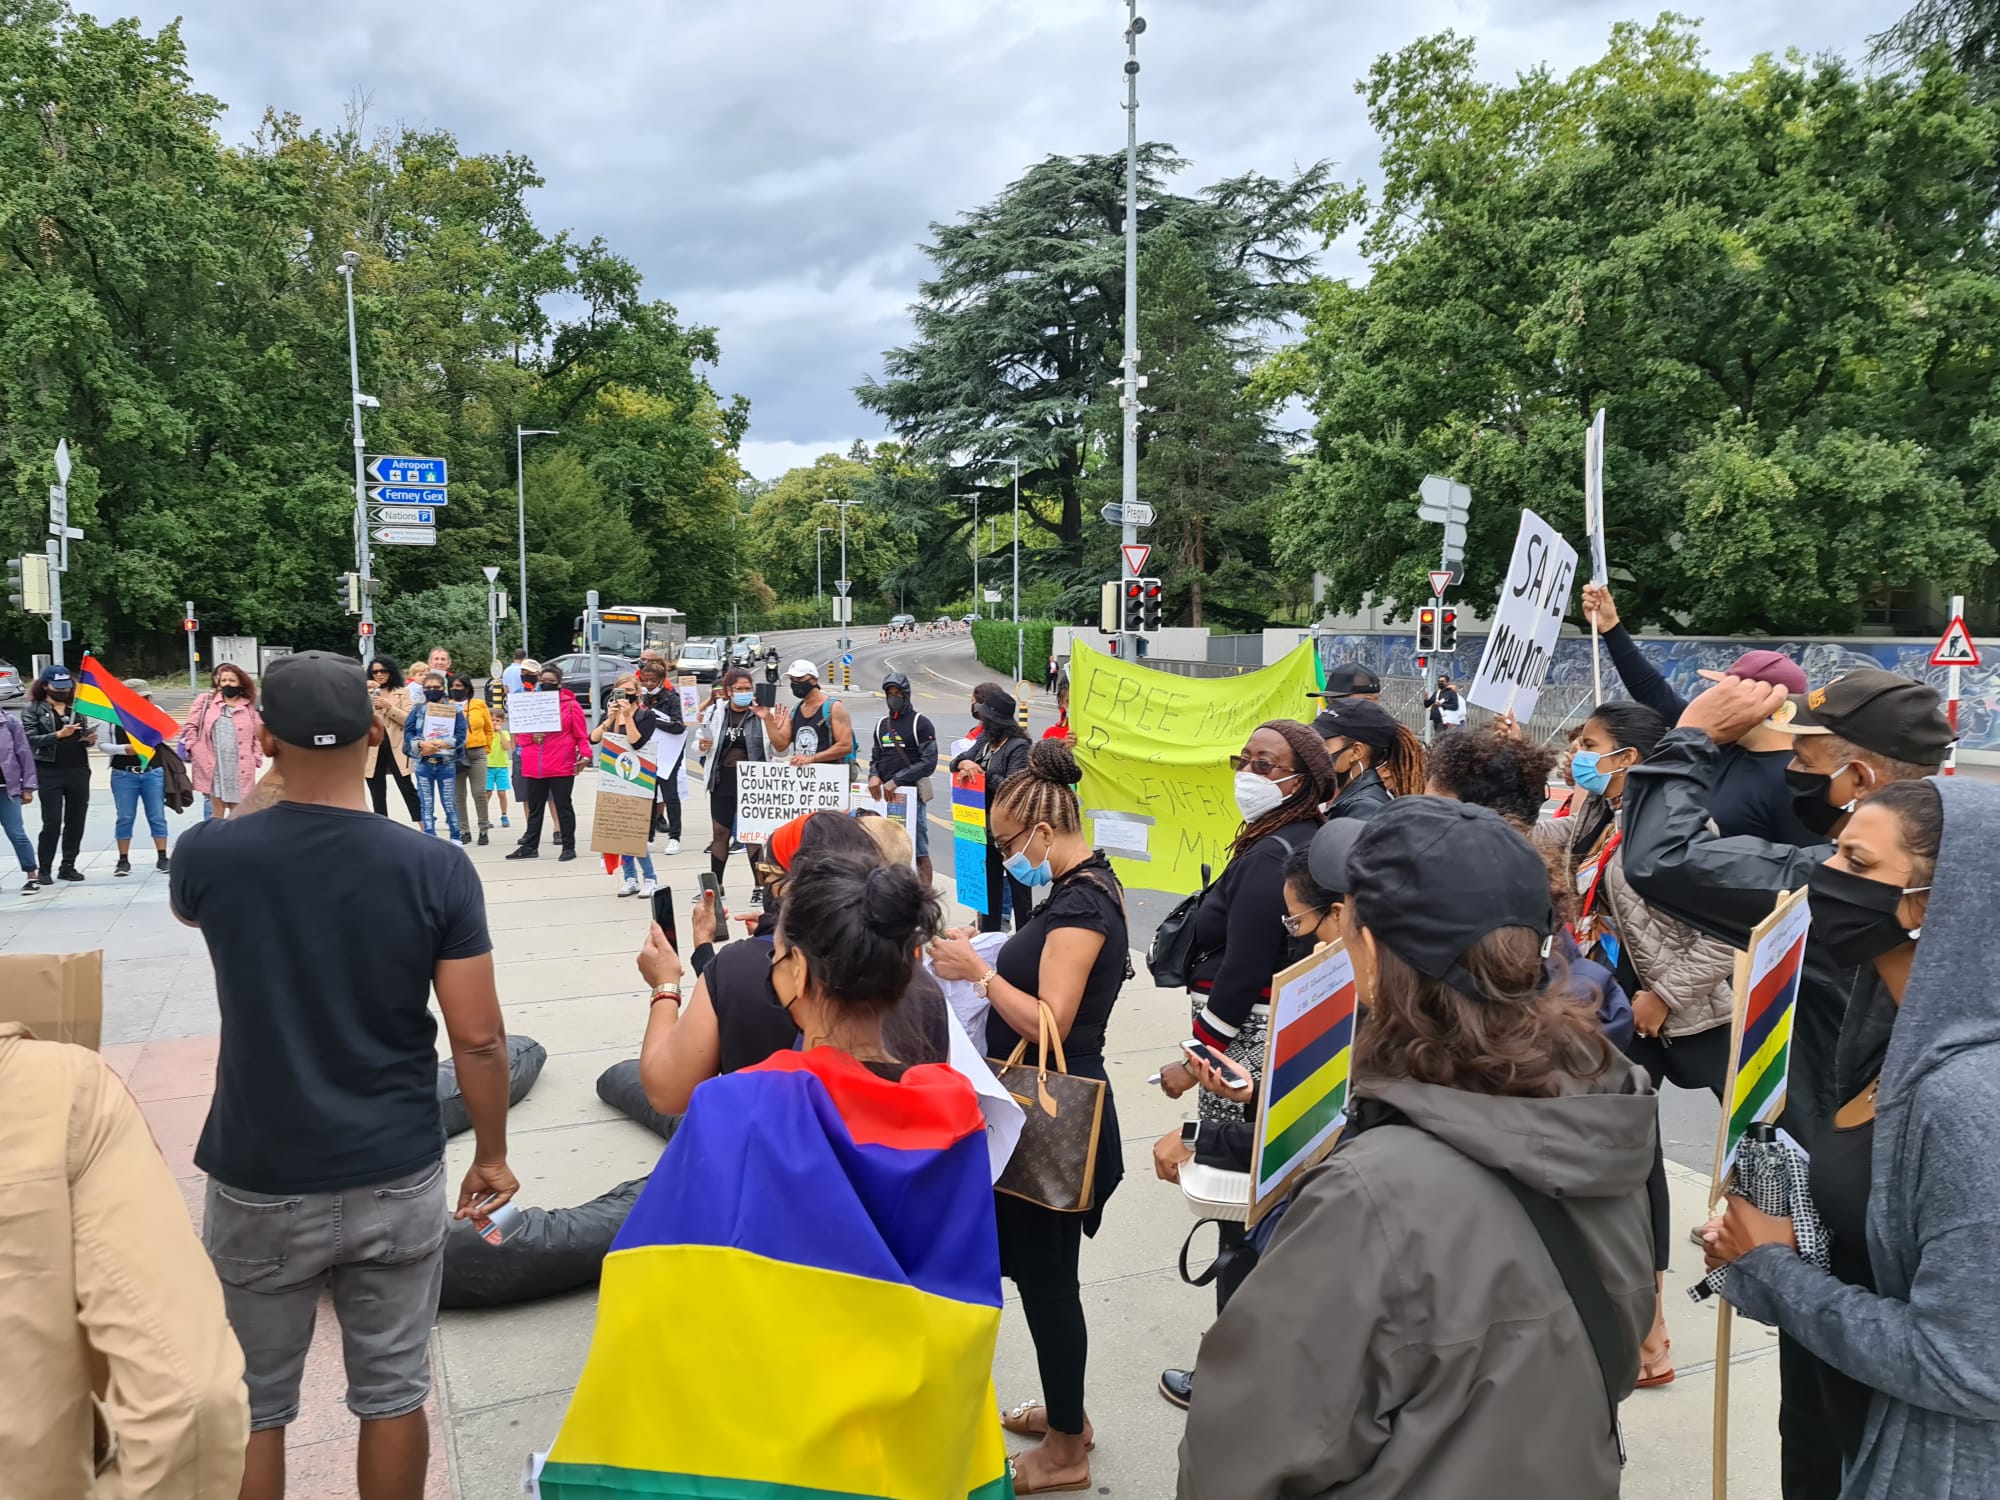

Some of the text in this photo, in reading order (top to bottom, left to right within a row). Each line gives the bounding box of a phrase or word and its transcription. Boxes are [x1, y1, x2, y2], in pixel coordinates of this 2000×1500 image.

[392, 460, 434, 470] Aéroport
[385, 489, 444, 502] Ferney Gex
[385, 511, 417, 520] Nations
[1127, 505, 1149, 522] Pregny
[1513, 534, 1572, 617] SAVE
[1084, 668, 1189, 732] FREE
[739, 764, 817, 779] WE LOVE OUR
[799, 781, 817, 792] WE
[818, 781, 840, 793] ARE
[740, 793, 840, 807] ASHAMED OF OUR
